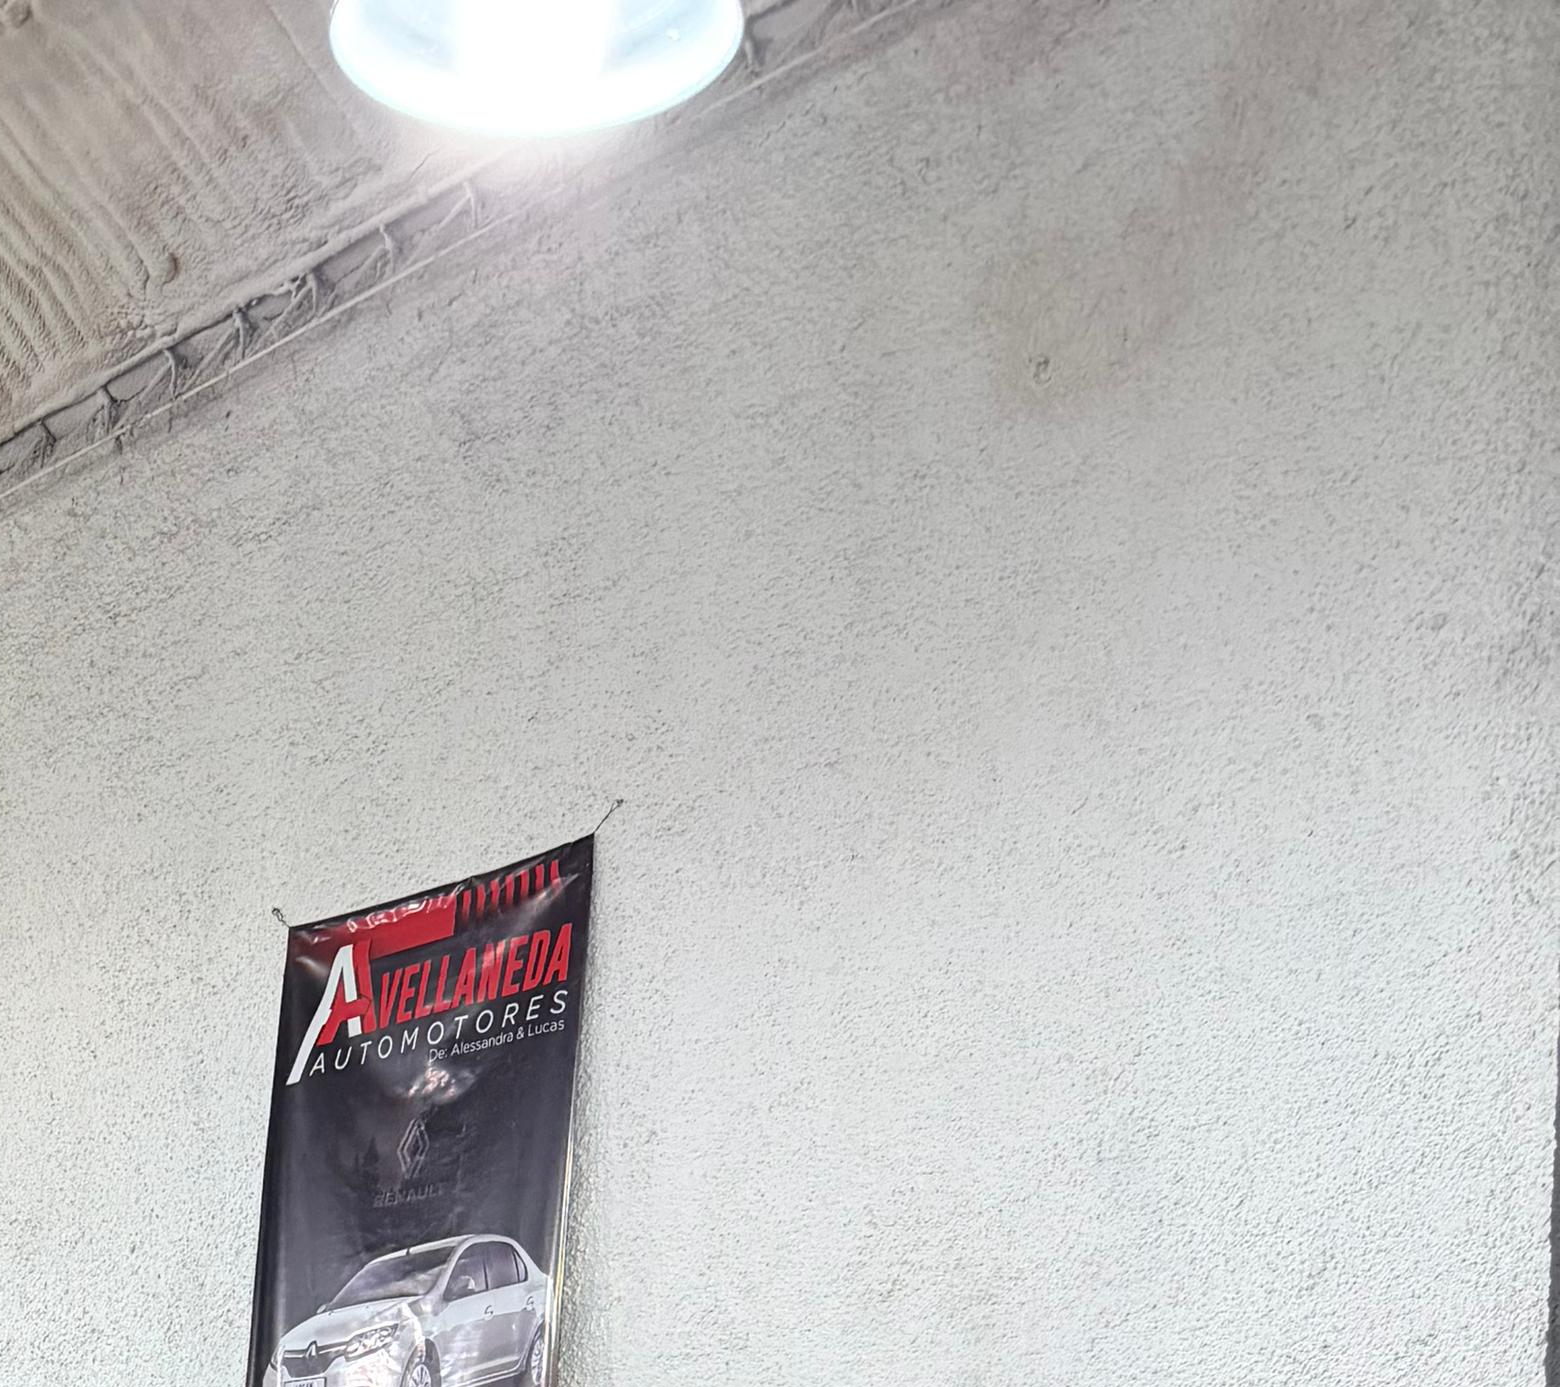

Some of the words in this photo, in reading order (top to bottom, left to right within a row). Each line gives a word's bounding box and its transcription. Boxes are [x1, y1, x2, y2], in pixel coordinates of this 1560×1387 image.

[286, 923, 573, 1085] AVELLANEDA
[309, 990, 569, 1076] AUTOMOTORES
[429, 1048, 448, 1063] De:
[450, 1032, 514, 1057] Alessandra
[516, 1027, 525, 1040] &
[527, 1020, 565, 1037] Lucas
